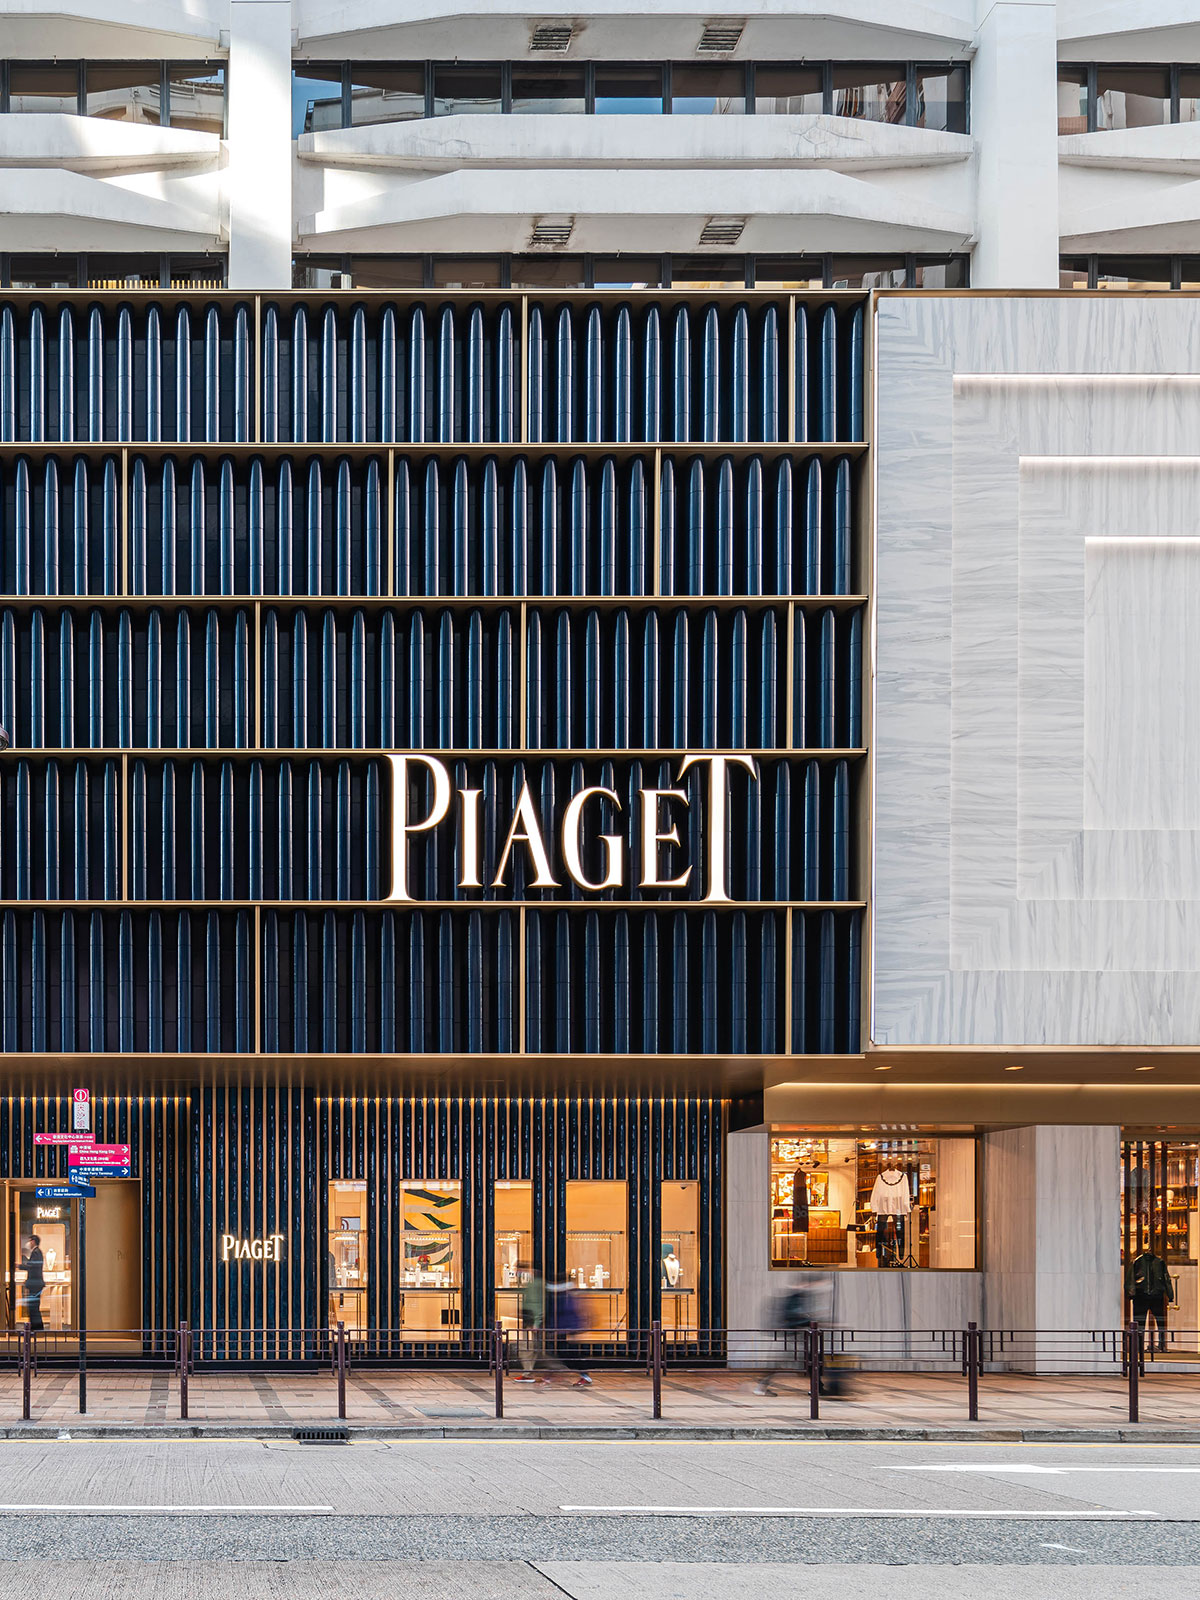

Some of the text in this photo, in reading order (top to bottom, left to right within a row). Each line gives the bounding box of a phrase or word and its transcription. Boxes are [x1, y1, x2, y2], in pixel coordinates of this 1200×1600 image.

[381, 754, 757, 902] PIAGET
[36, 1207, 61, 1219] PIAGET
[222, 1234, 284, 1262] PIAGET
